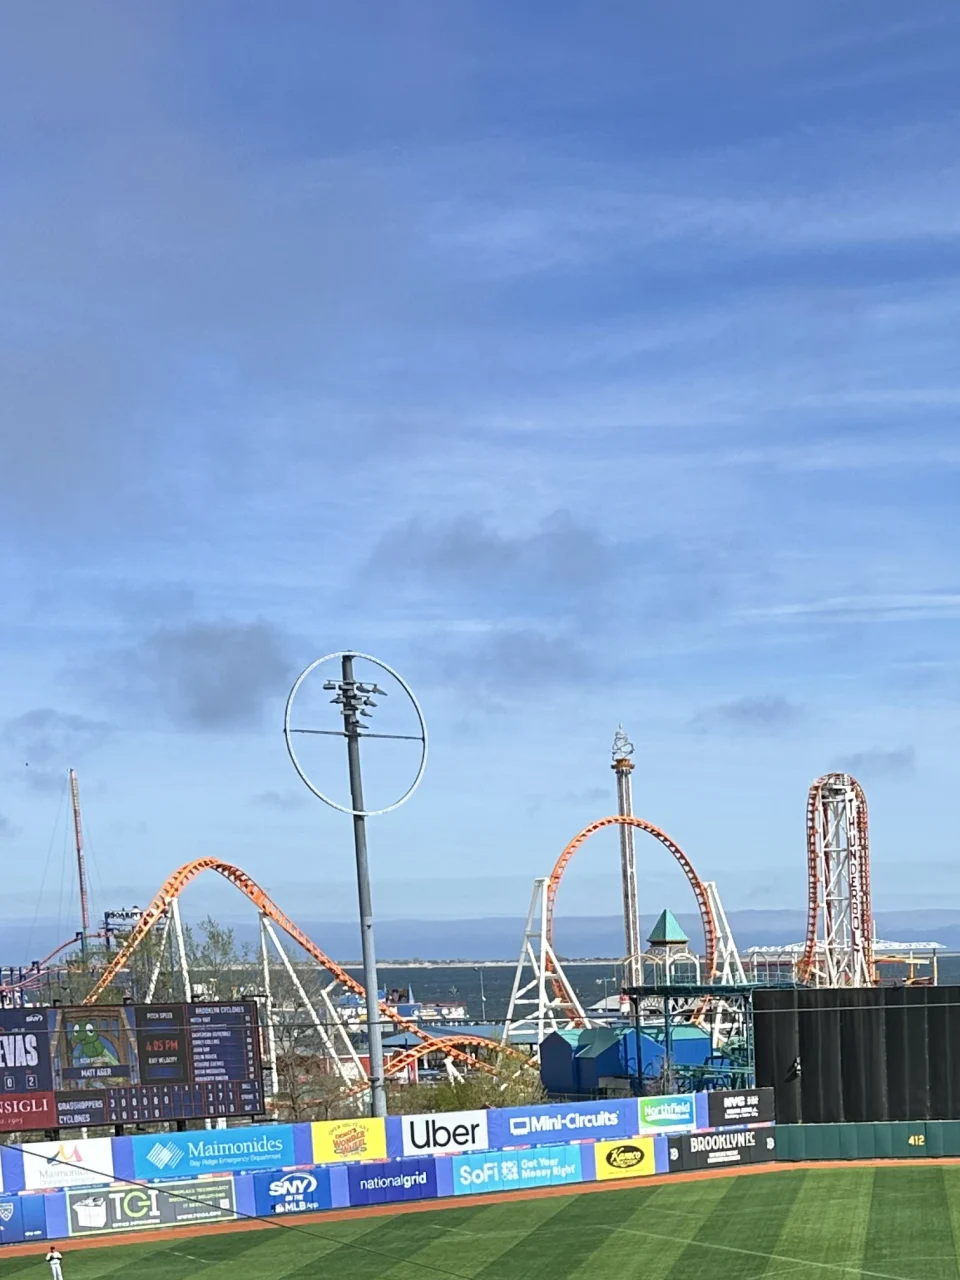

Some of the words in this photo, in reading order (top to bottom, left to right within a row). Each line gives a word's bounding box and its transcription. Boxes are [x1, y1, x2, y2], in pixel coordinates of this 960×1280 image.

[165, 1040, 178, 1051] PM
[0, 1099, 48, 1114] SIGLI
[58, 1100, 103, 1110] GRASSHOPPERS
[644, 1102, 690, 1116] Northfield
[59, 1114, 90, 1124] CYCLONES
[219, 1105, 225, 1113] 11
[531, 1111, 619, 1132] Mini-Circuits
[410, 1119, 480, 1149] Uber
[908, 1135, 925, 1146] 412
[188, 1135, 283, 1157] Maimonides
[691, 1132, 745, 1153] BROOKLYN
[521, 1159, 537, 1168] Get
[538, 1158, 559, 1167] Your
[460, 1162, 499, 1185] SoFi
[521, 1168, 551, 1179] Money
[552, 1164, 576, 1178] Right
[269, 1179, 309, 1196] SNY
[360, 1171, 427, 1190] nationalgrid
[285, 1202, 306, 1212] MLB
